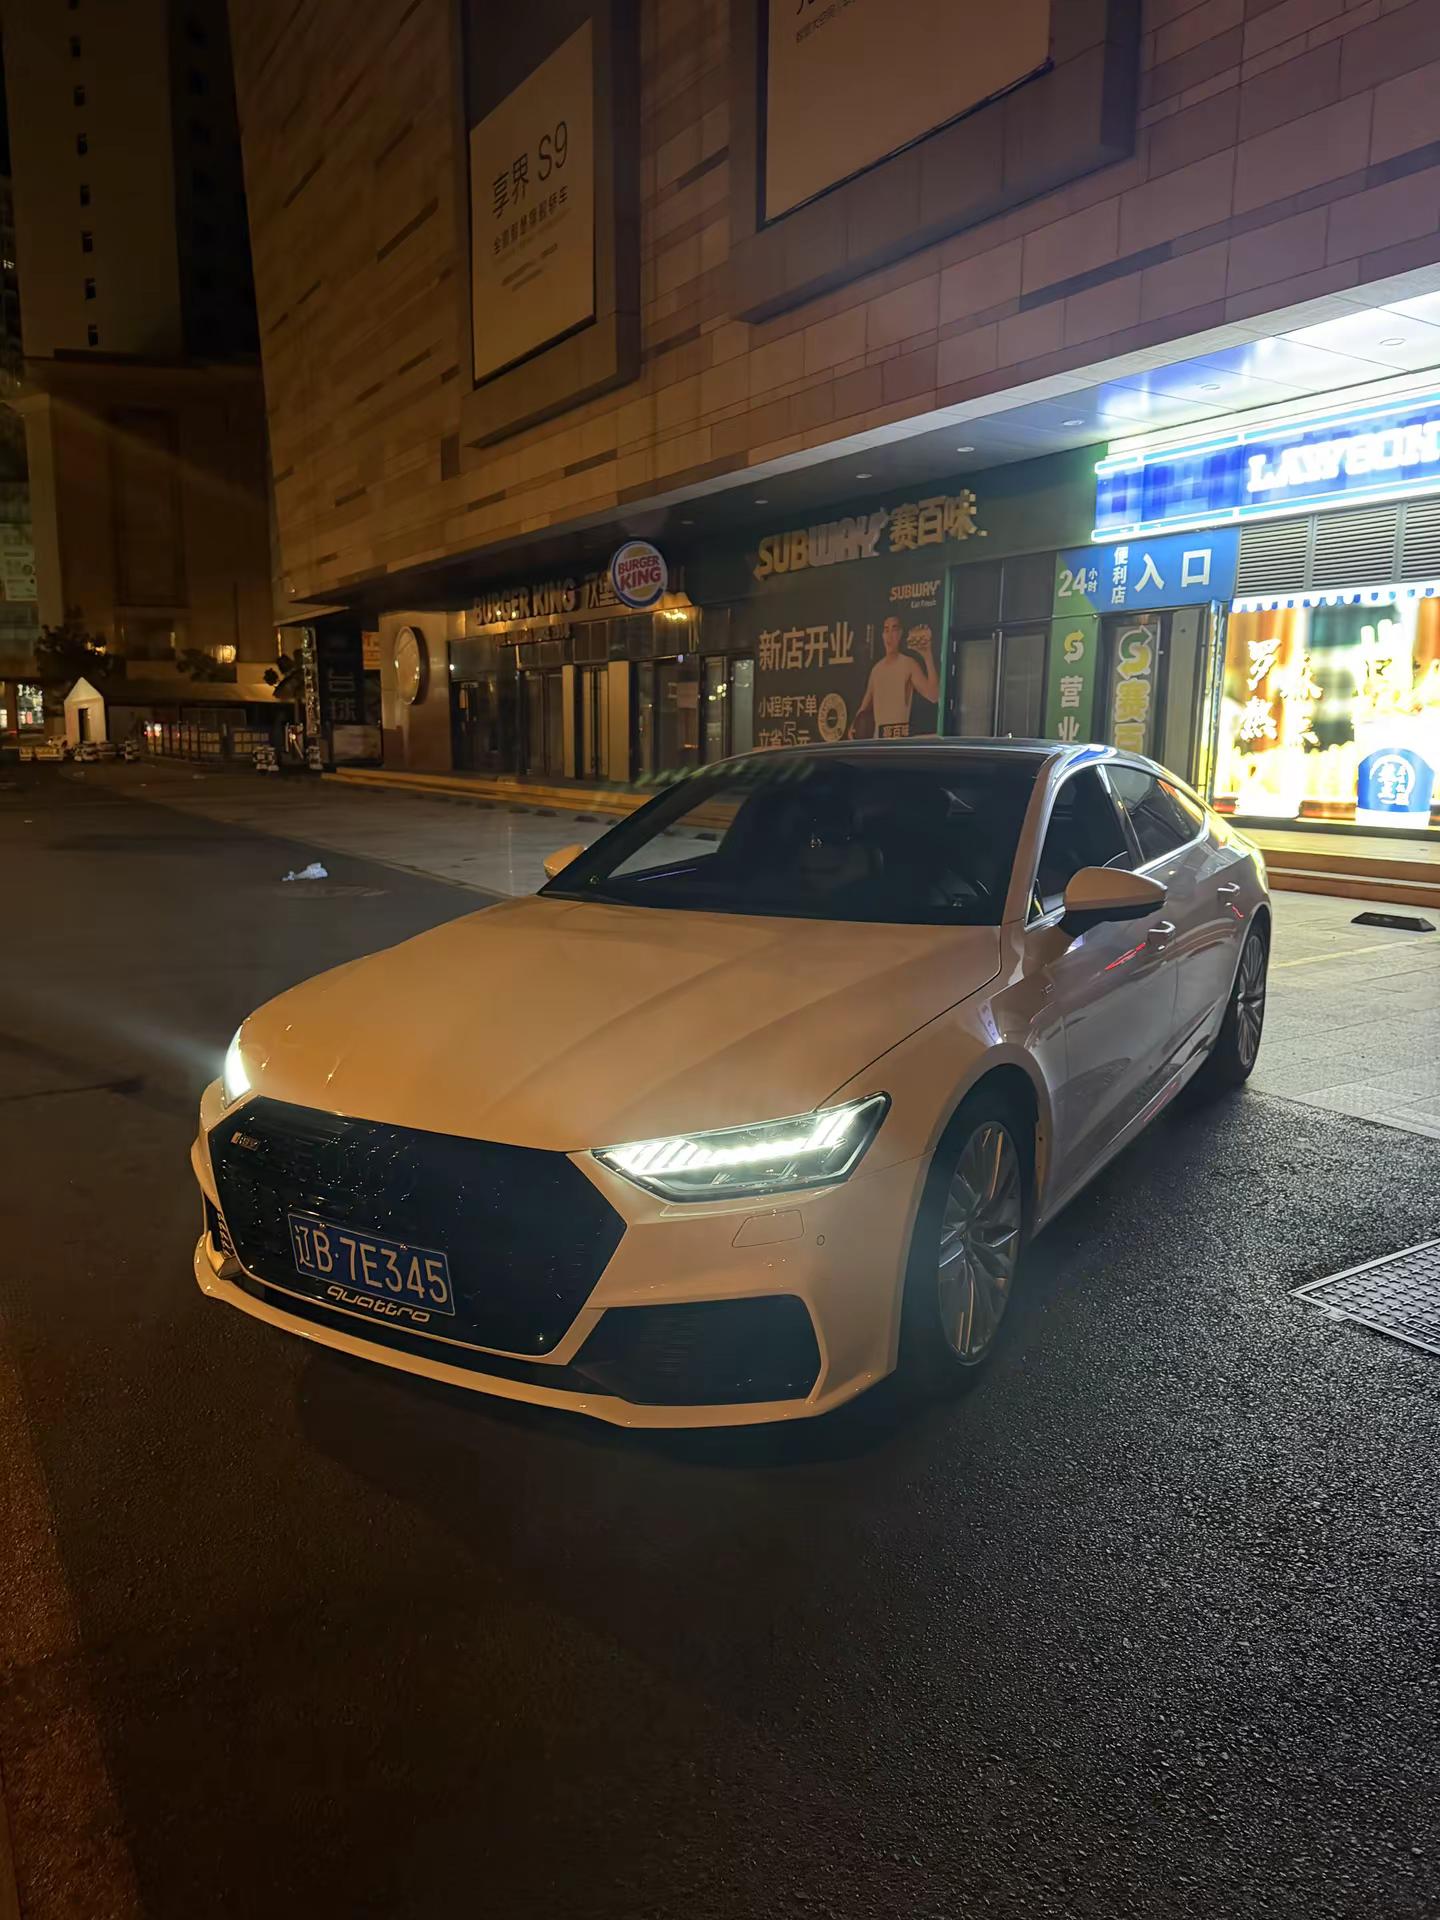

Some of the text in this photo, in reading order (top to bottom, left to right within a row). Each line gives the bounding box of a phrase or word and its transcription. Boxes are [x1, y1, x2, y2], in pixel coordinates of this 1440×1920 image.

[492, 121, 569, 219] 享界 S9
[753, 489, 986, 581] SUBWAY 赛百味
[619, 555, 660, 574] BURGER
[620, 567, 661, 591] KING
[1111, 546, 1129, 605] 便利店
[1134, 548, 1212, 592] 入口
[474, 586, 531, 625] BURGER
[532, 577, 577, 617] KING
[889, 580, 941, 602] SUBWAY
[758, 622, 854, 671] 新店开业
[758, 695, 817, 718] 小程序下单
[294, 1224, 449, 1304] 辽B·7E345
[326, 1284, 431, 1323] quattro
